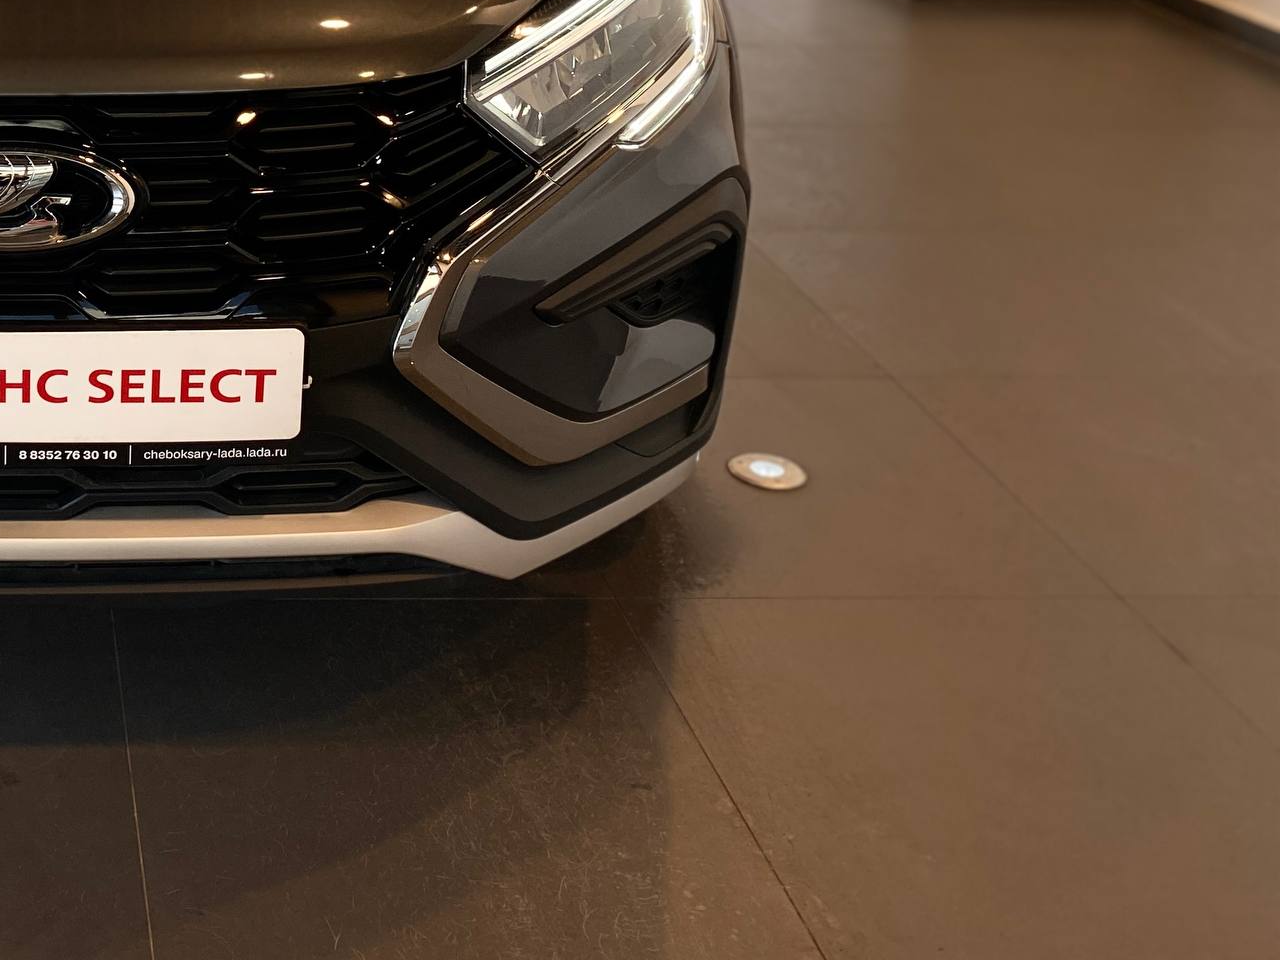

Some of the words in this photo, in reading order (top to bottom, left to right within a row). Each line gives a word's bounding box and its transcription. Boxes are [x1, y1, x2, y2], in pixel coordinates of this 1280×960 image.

[86, 367, 279, 405] SELECT
[18, 449, 28, 460] 8
[29, 449, 63, 460] 8352
[64, 449, 81, 460] 76
[82, 449, 100, 460] 30
[102, 449, 118, 460] 10
[142, 446, 288, 461] cheboksary-lada.lada.ru
